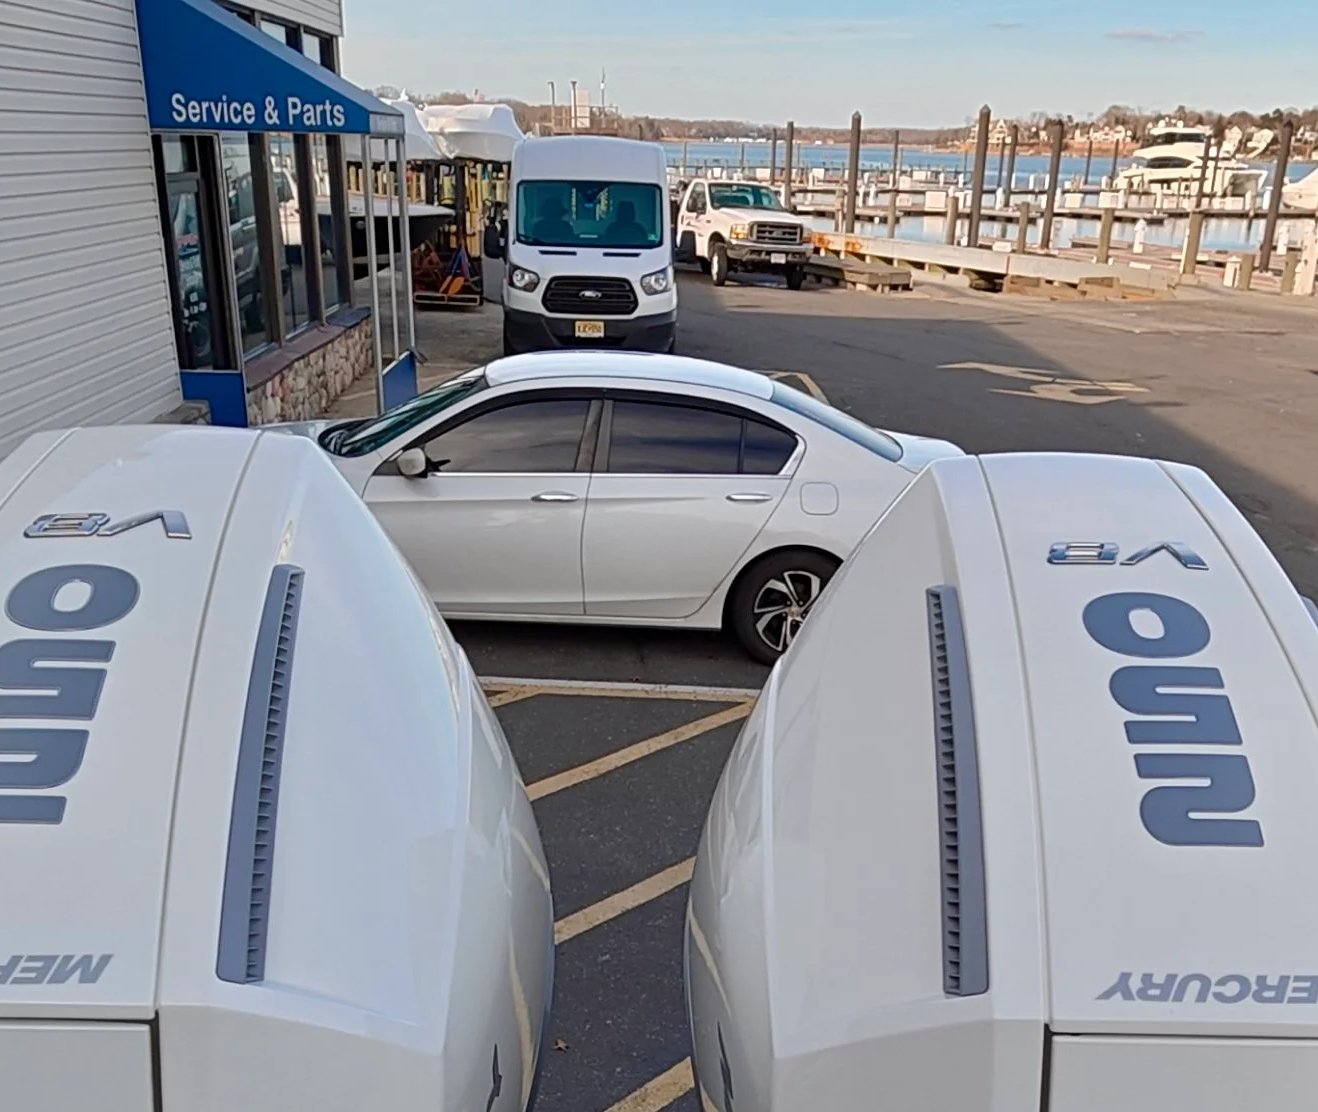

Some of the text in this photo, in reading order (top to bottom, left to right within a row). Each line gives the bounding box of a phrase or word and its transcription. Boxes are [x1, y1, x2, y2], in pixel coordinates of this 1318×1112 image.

[171, 92, 345, 128] Service & Parts
[23, 510, 192, 540] V8
[1046, 540, 1209, 571] V8
[1081, 591, 1265, 849] 250
